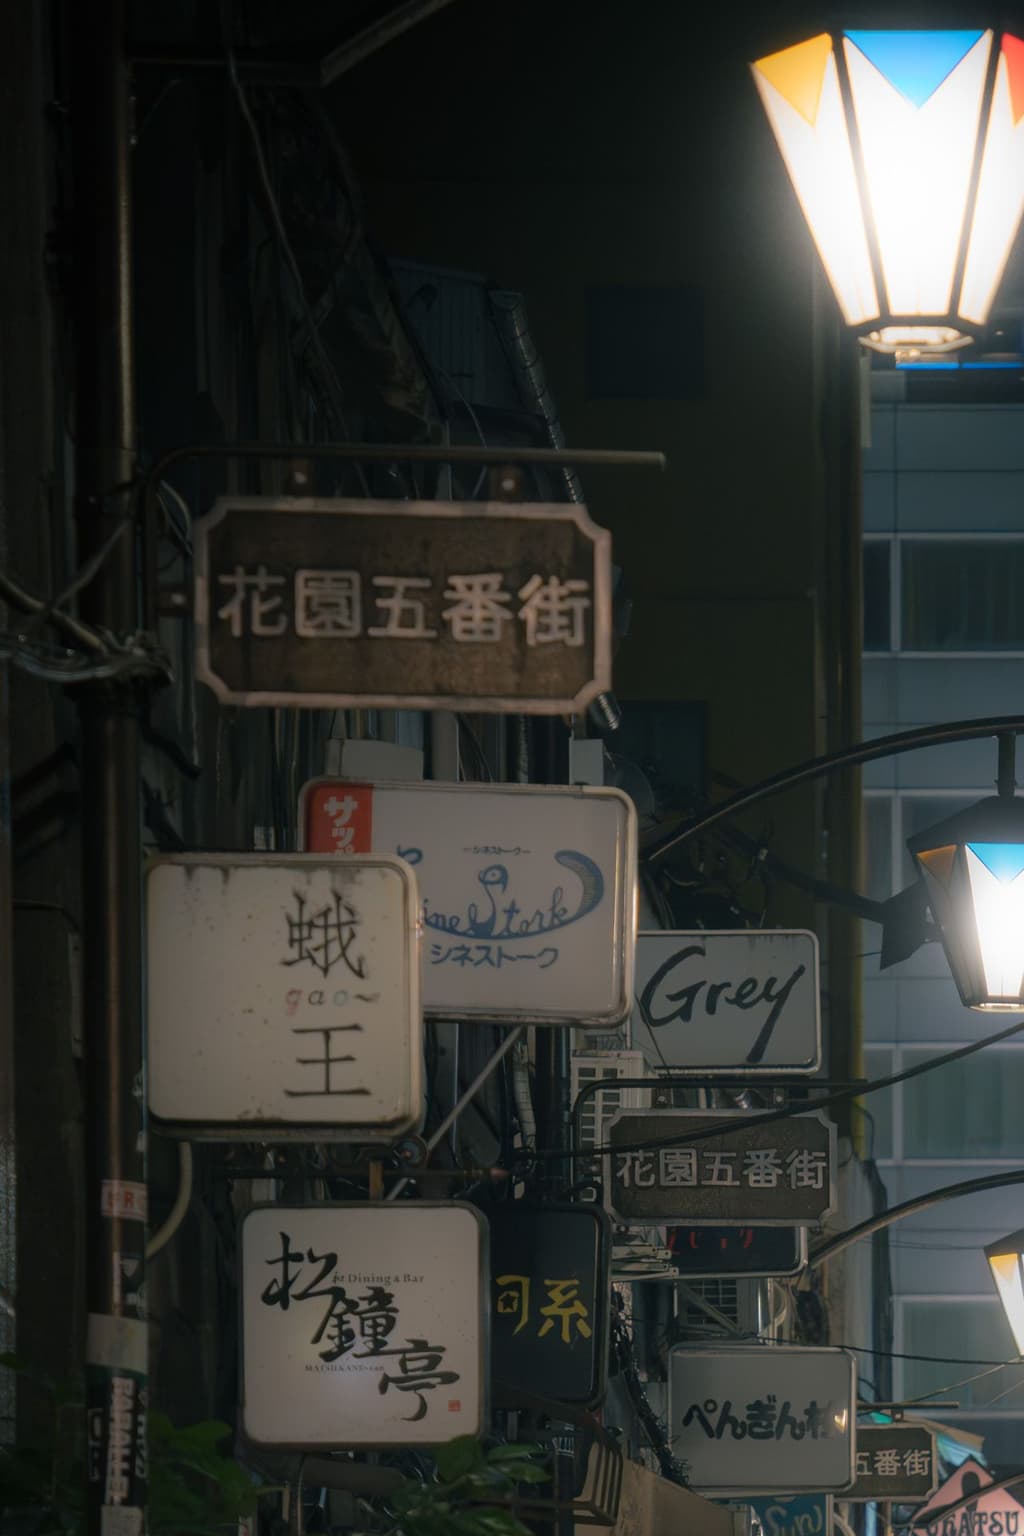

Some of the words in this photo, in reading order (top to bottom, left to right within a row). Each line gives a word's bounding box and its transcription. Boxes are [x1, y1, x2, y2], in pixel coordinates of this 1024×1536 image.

[218, 565, 590, 647] 花園五番街
[431, 944, 559, 969] シネストーク
[637, 946, 806, 1062] Grey
[617, 1148, 828, 1190] 花園五番街
